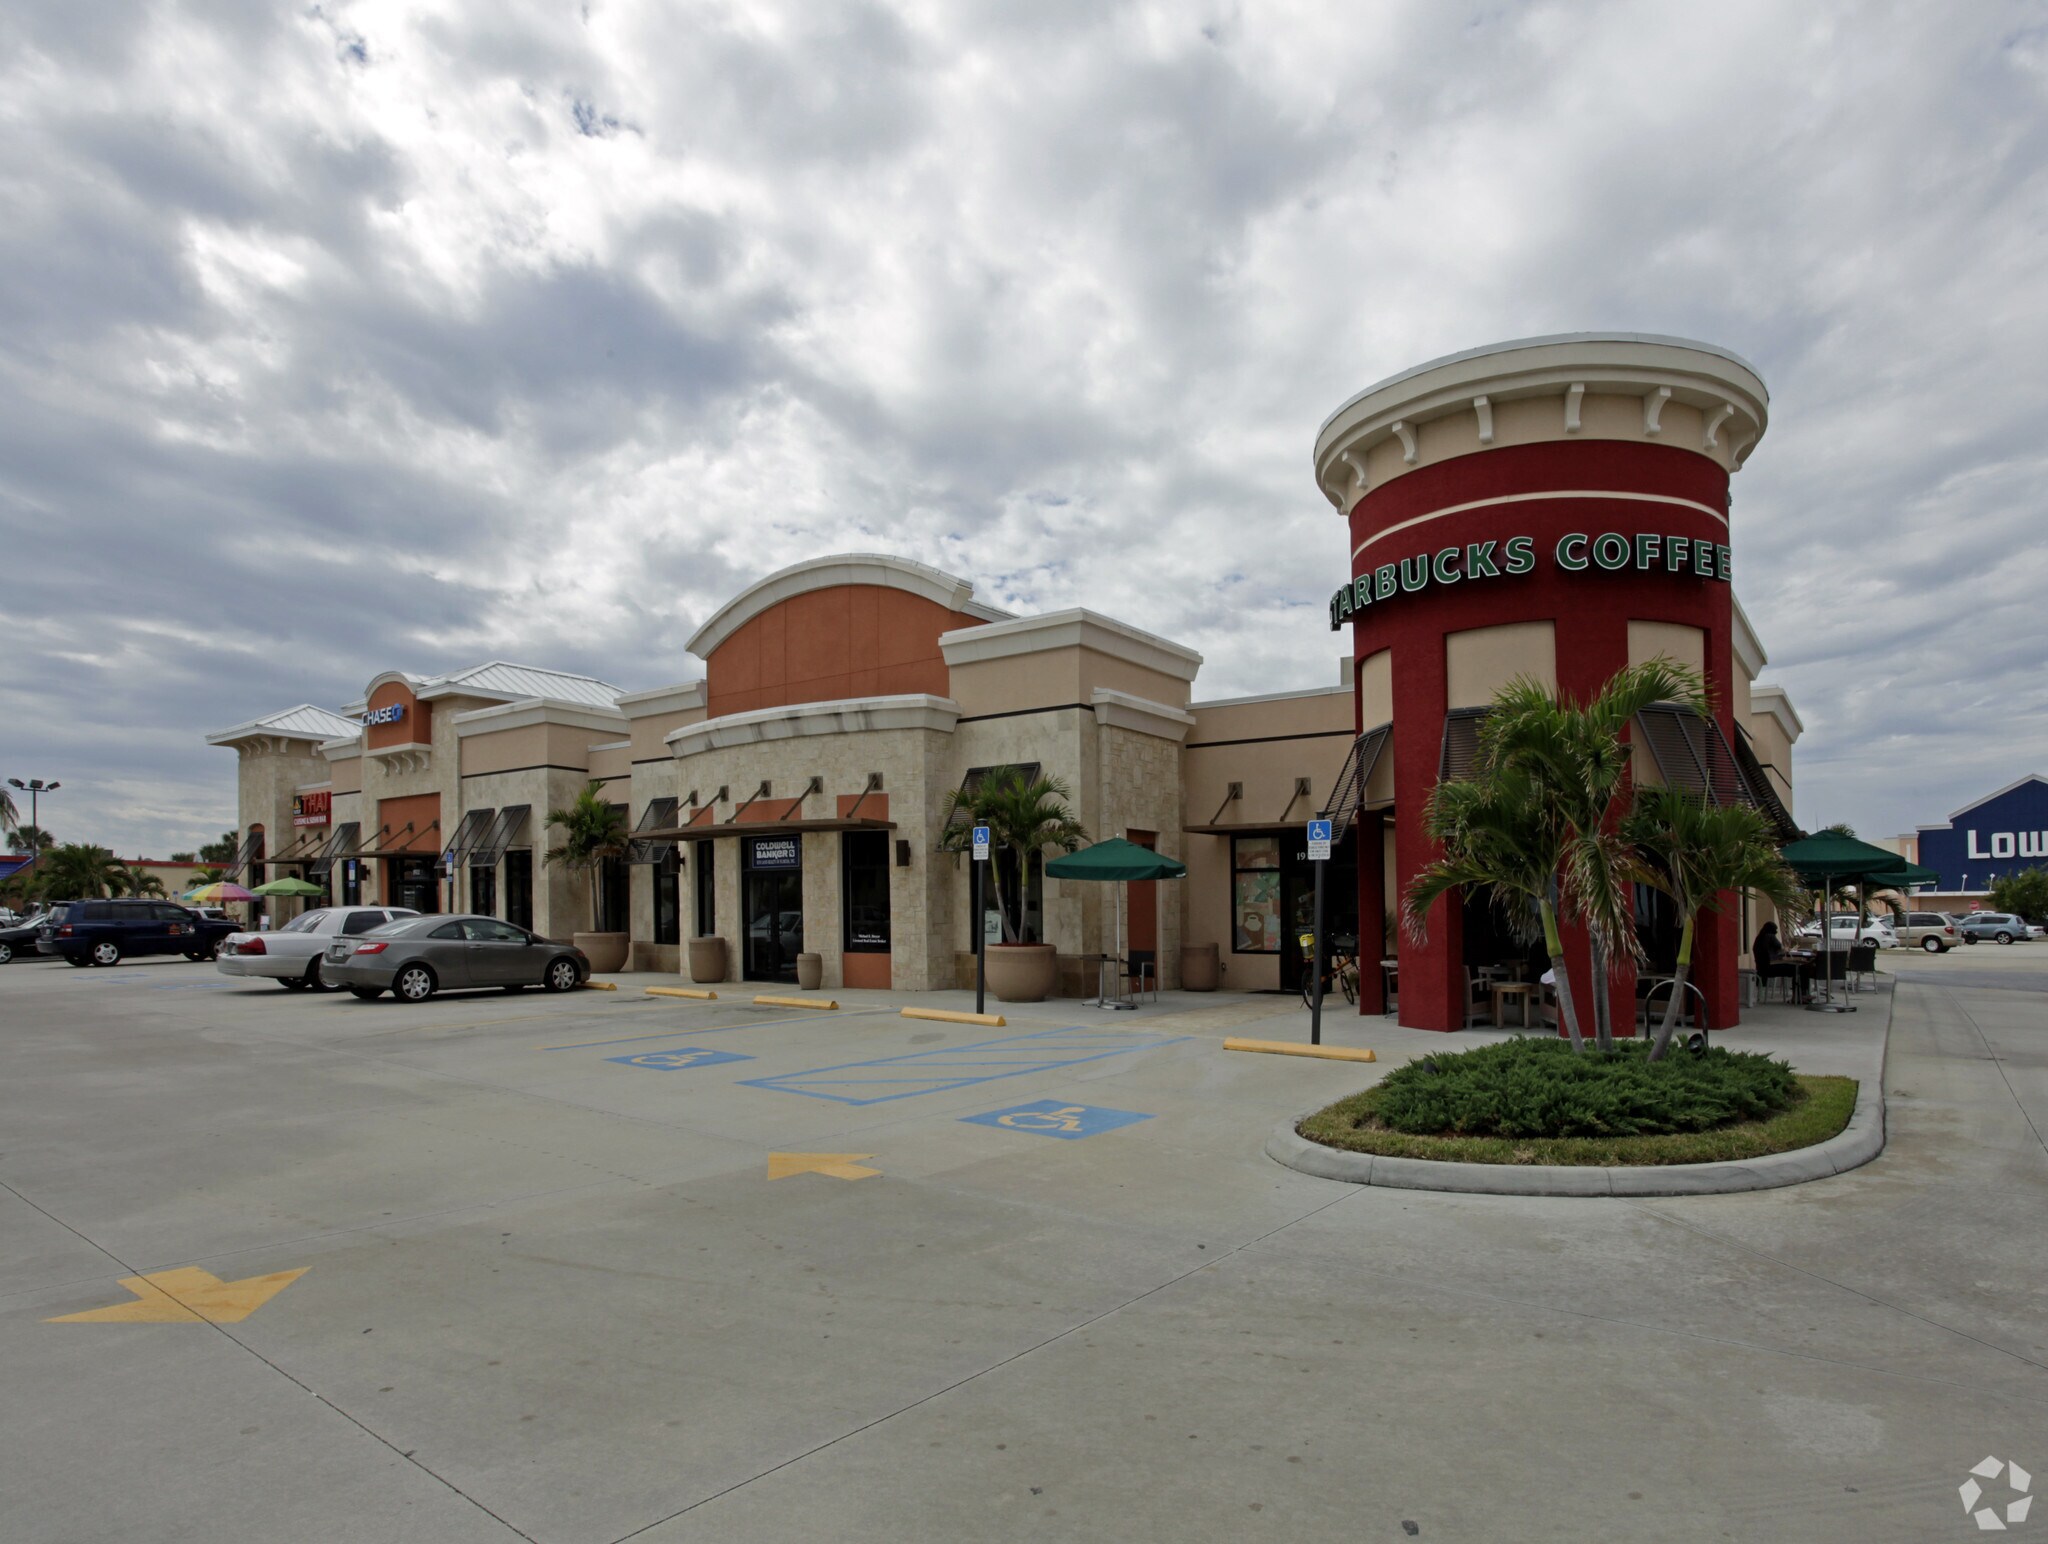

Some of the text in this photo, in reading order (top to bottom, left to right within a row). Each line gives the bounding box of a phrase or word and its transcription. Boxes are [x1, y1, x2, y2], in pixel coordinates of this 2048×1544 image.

[1556, 532, 1732, 582] COFFEE
[362, 706, 392, 726] CHASE
[302, 792, 328, 813] THAI
[756, 850, 788, 859] BANKER
